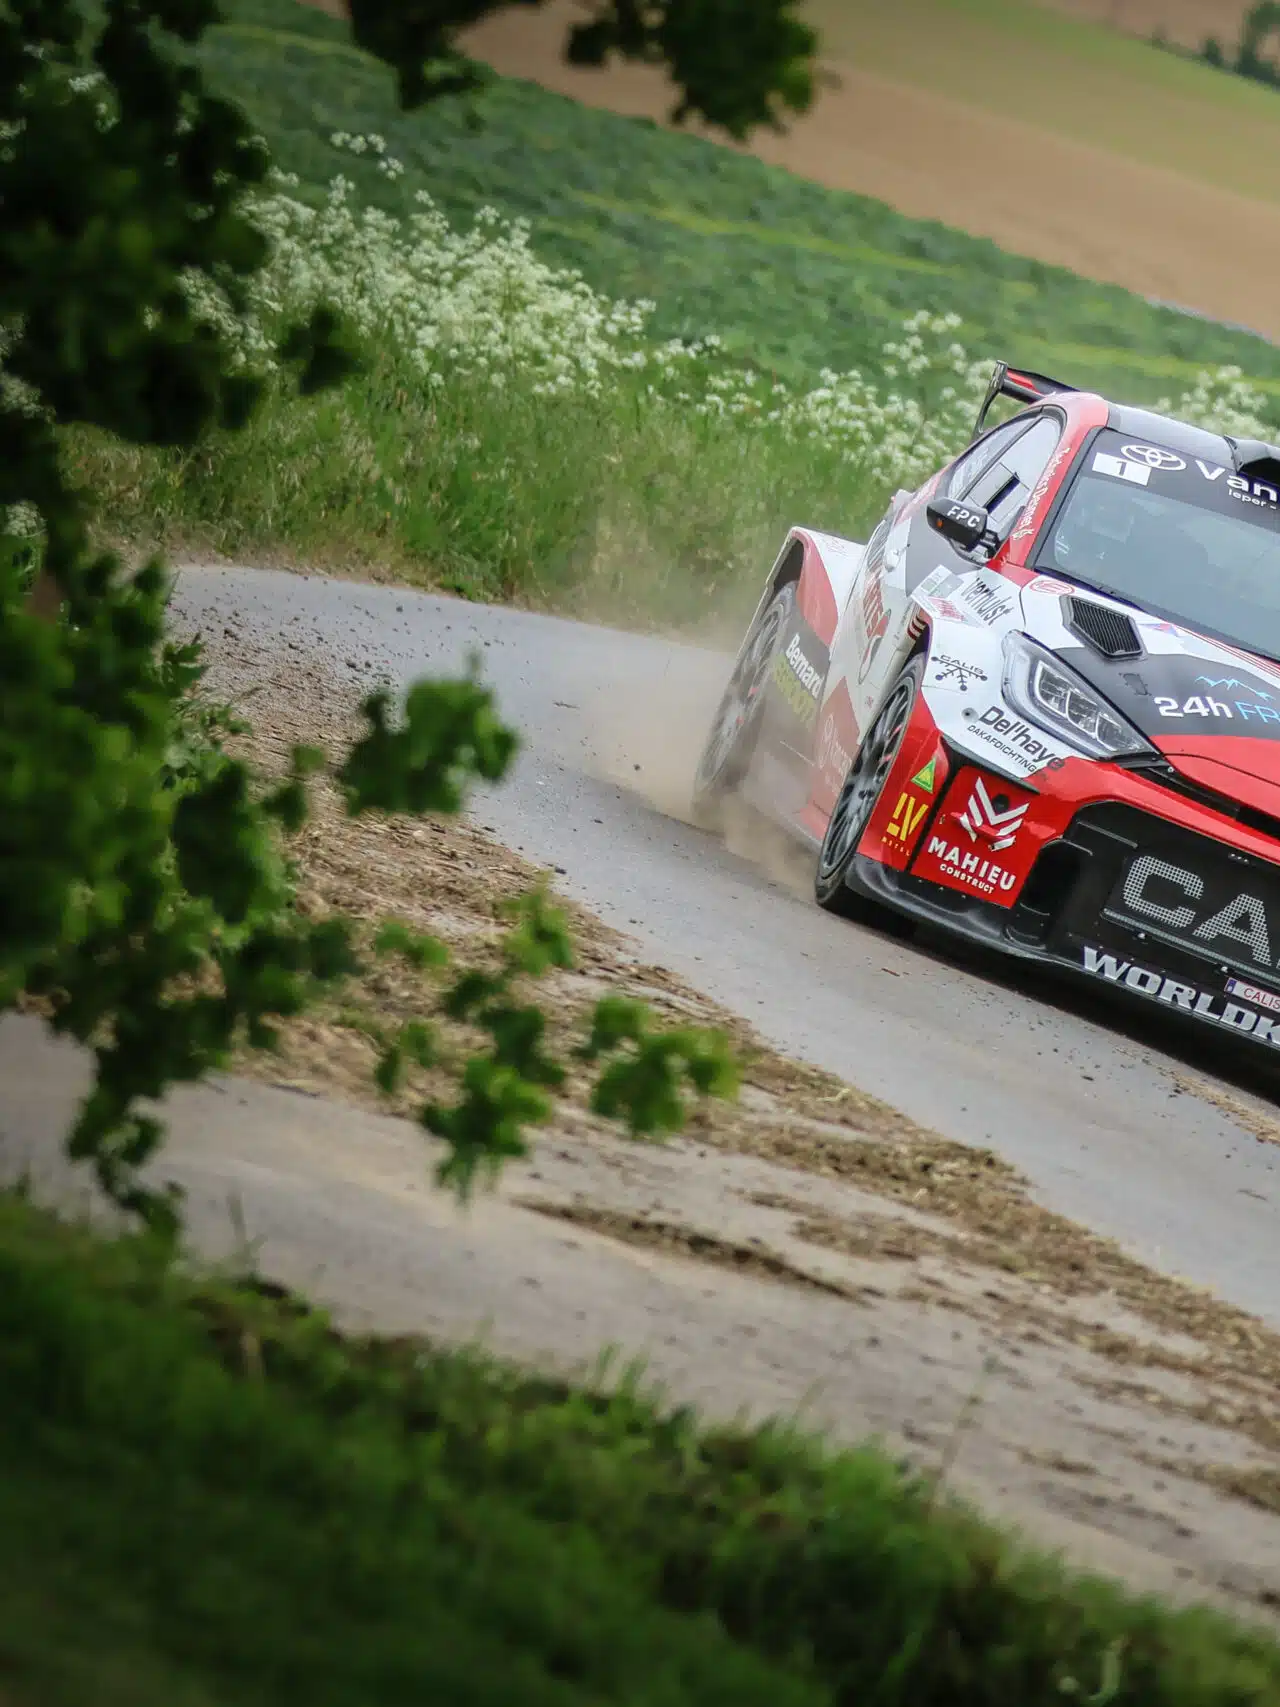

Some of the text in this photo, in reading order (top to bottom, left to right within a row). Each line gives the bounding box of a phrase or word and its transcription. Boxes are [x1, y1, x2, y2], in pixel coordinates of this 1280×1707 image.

[1115, 460, 1127, 476] 1
[1228, 489, 1266, 508] Ieper
[947, 505, 980, 528] FPC
[960, 577, 1014, 626] verhulst
[785, 632, 825, 700] Bernard
[940, 655, 985, 675] CALIS
[1154, 696, 1234, 718] 24h
[978, 706, 1065, 771] Del'haye
[928, 836, 1017, 891] MAHIEU
[939, 863, 995, 895] CONSTRUCT
